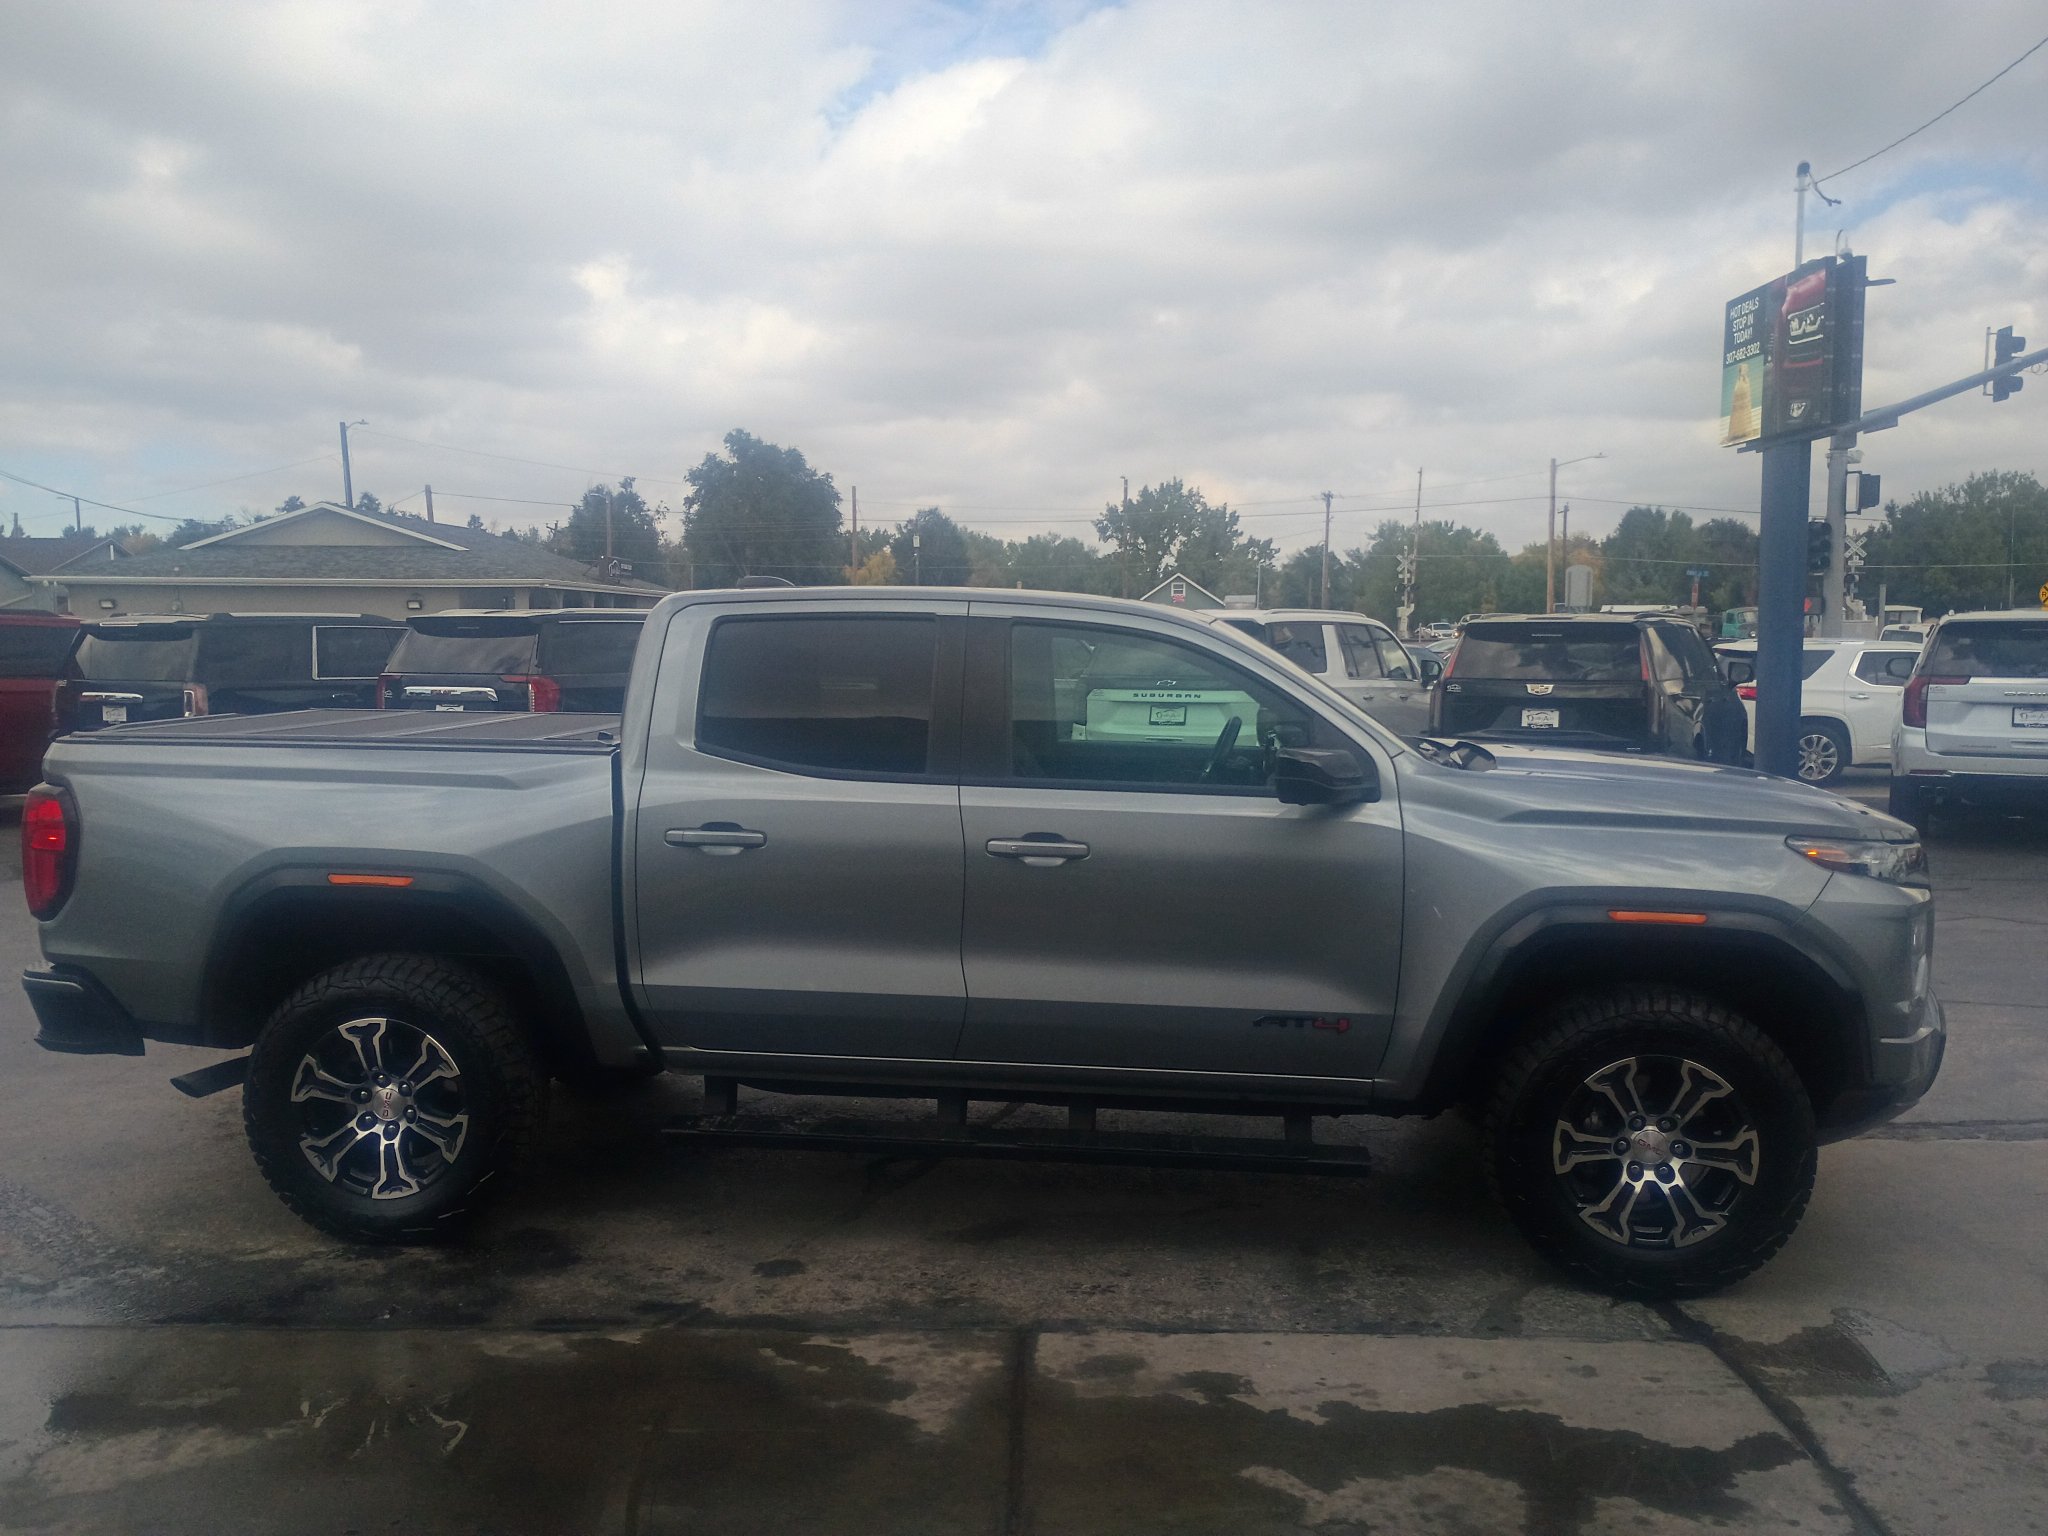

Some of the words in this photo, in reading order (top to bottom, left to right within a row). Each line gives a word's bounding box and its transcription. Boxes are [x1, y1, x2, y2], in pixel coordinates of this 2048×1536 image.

[1729, 304, 1742, 321] HOT
[1741, 296, 1760, 316] DEALS
[1732, 315, 1748, 332] STOP
[1747, 311, 1754, 326] IN
[1253, 1015, 1350, 1034] AT4
[1637, 1138, 1665, 1156] GMC
